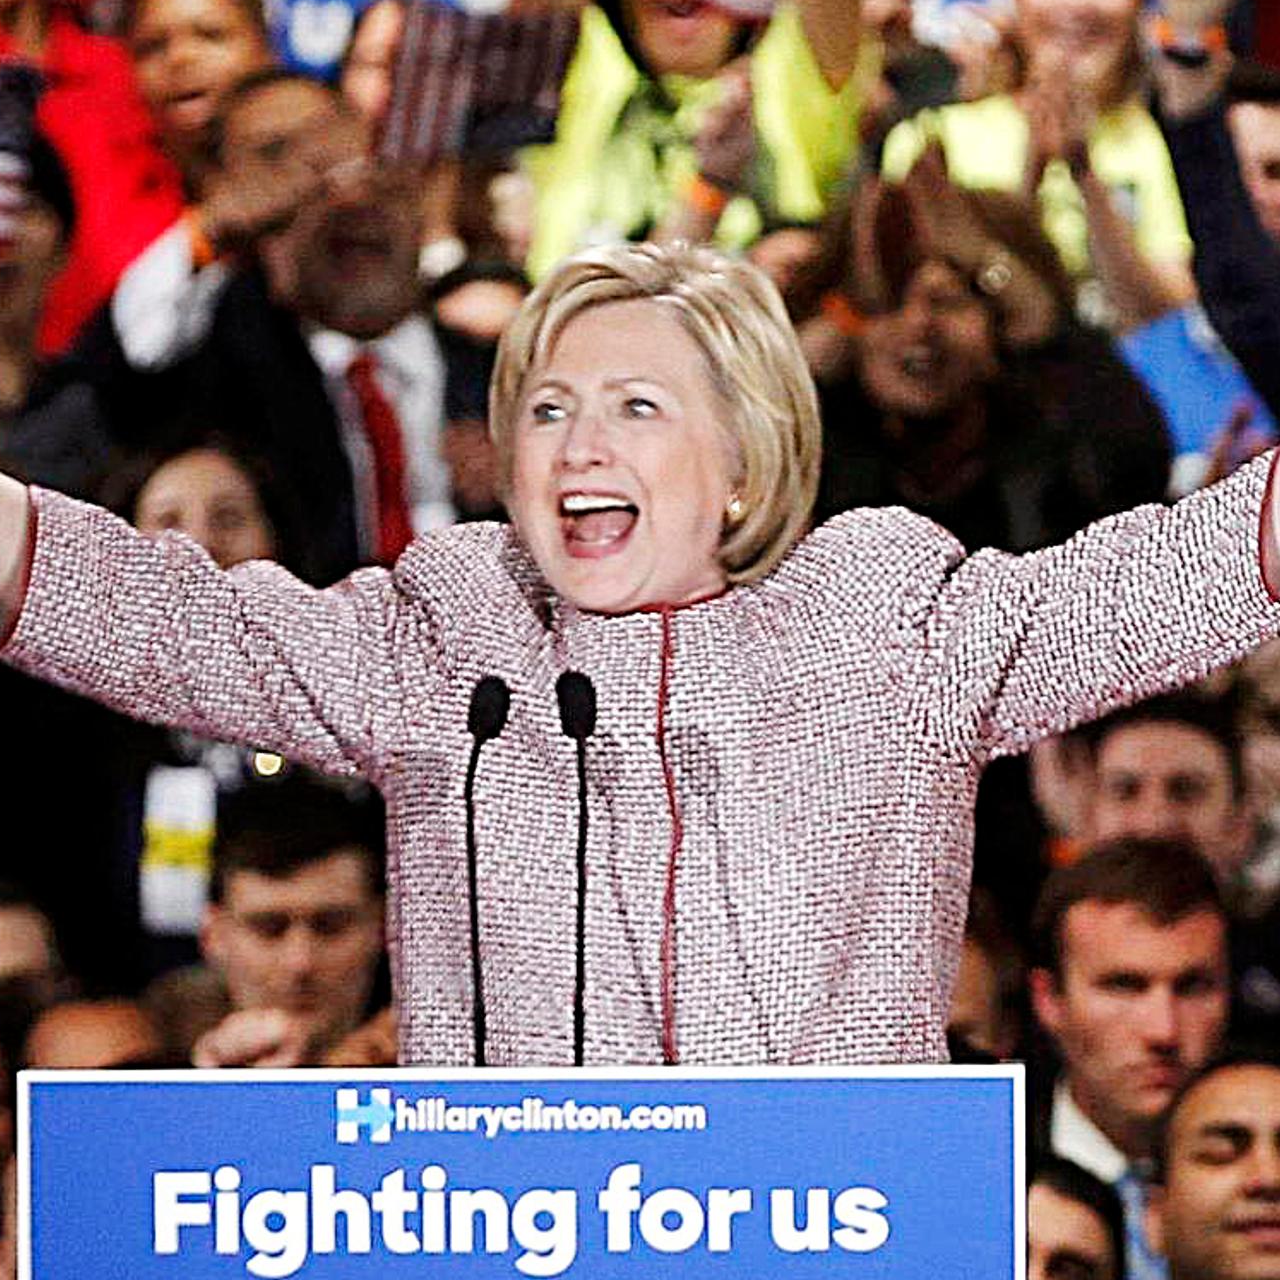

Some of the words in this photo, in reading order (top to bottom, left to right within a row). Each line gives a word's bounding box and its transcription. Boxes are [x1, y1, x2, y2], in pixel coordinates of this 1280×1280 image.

[395, 1097, 707, 1137] hillaryclinton.com
[152, 1164, 578, 1279] Fighting
[598, 1162, 752, 1254] for
[770, 1185, 891, 1254] us
